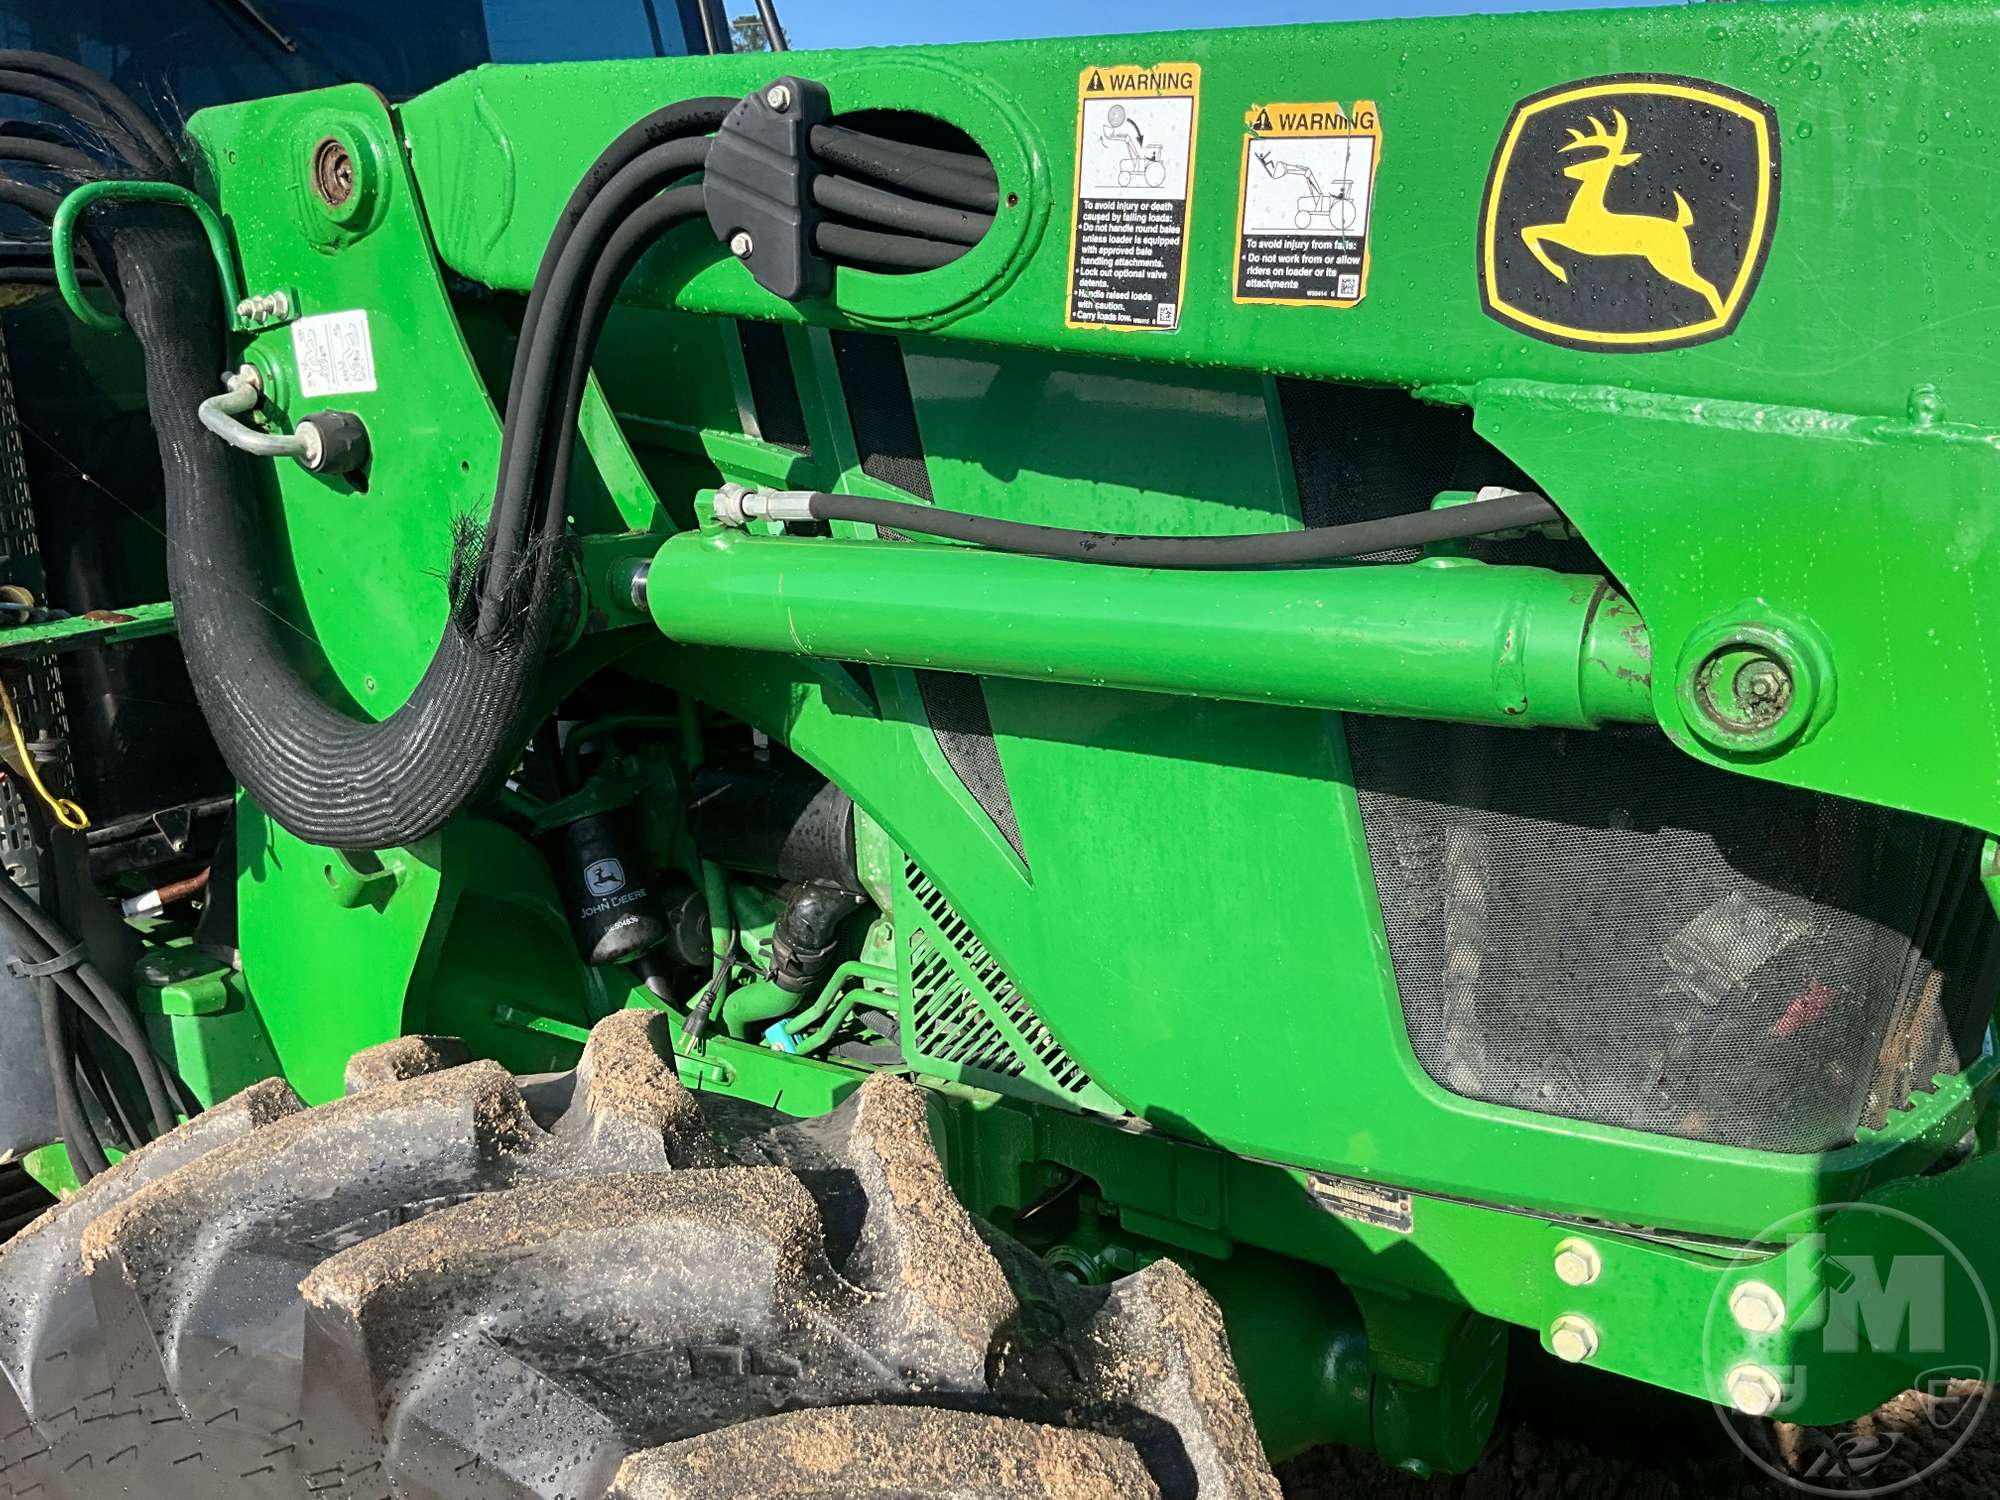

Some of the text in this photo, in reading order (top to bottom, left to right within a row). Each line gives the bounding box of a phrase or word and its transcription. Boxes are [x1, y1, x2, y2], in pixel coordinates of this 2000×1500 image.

[1110, 73, 1192, 91] WARNING
[1084, 200, 1093, 210] To
[1095, 201, 1115, 210] avoid
[1117, 202, 1138, 211] injury
[1151, 202, 1173, 211] death
[1083, 212, 1172, 223] caused by falling loads:
[1084, 223, 1093, 231] Do
[1109, 224, 1134, 232] handle
[1136, 224, 1158, 233] round
[1160, 225, 1180, 233] bales
[1083, 234, 1179, 246] unless loader is equipped
[1246, 239, 1255, 248] To
[1259, 240, 1282, 249] avoid
[1284, 240, 1309, 250] injury
[1312, 240, 1332, 249] from
[1082, 246, 1152, 256] with approved bale
[1081, 257, 1164, 267] handling attachments.
[1248, 253, 1259, 263] Do
[1262, 254, 1276, 263] not
[1278, 254, 1299, 263] work
[1302, 255, 1322, 264] from
[1336, 255, 1360, 264] allow
[1080, 268, 1167, 279] Lock out optional valve
[1247, 266, 1336, 276] riders on loader or its
[1079, 279, 1109, 287] detents.
[1246, 279, 1298, 289] attachments
[1106, 290, 1130, 299] raised
[1131, 291, 1152, 300] loads
[1078, 300, 1093, 308] with
[1077, 311, 1096, 320] Carry
[1097, 312, 1116, 320] loads
[581, 888, 647, 919] JOHN DEERE
